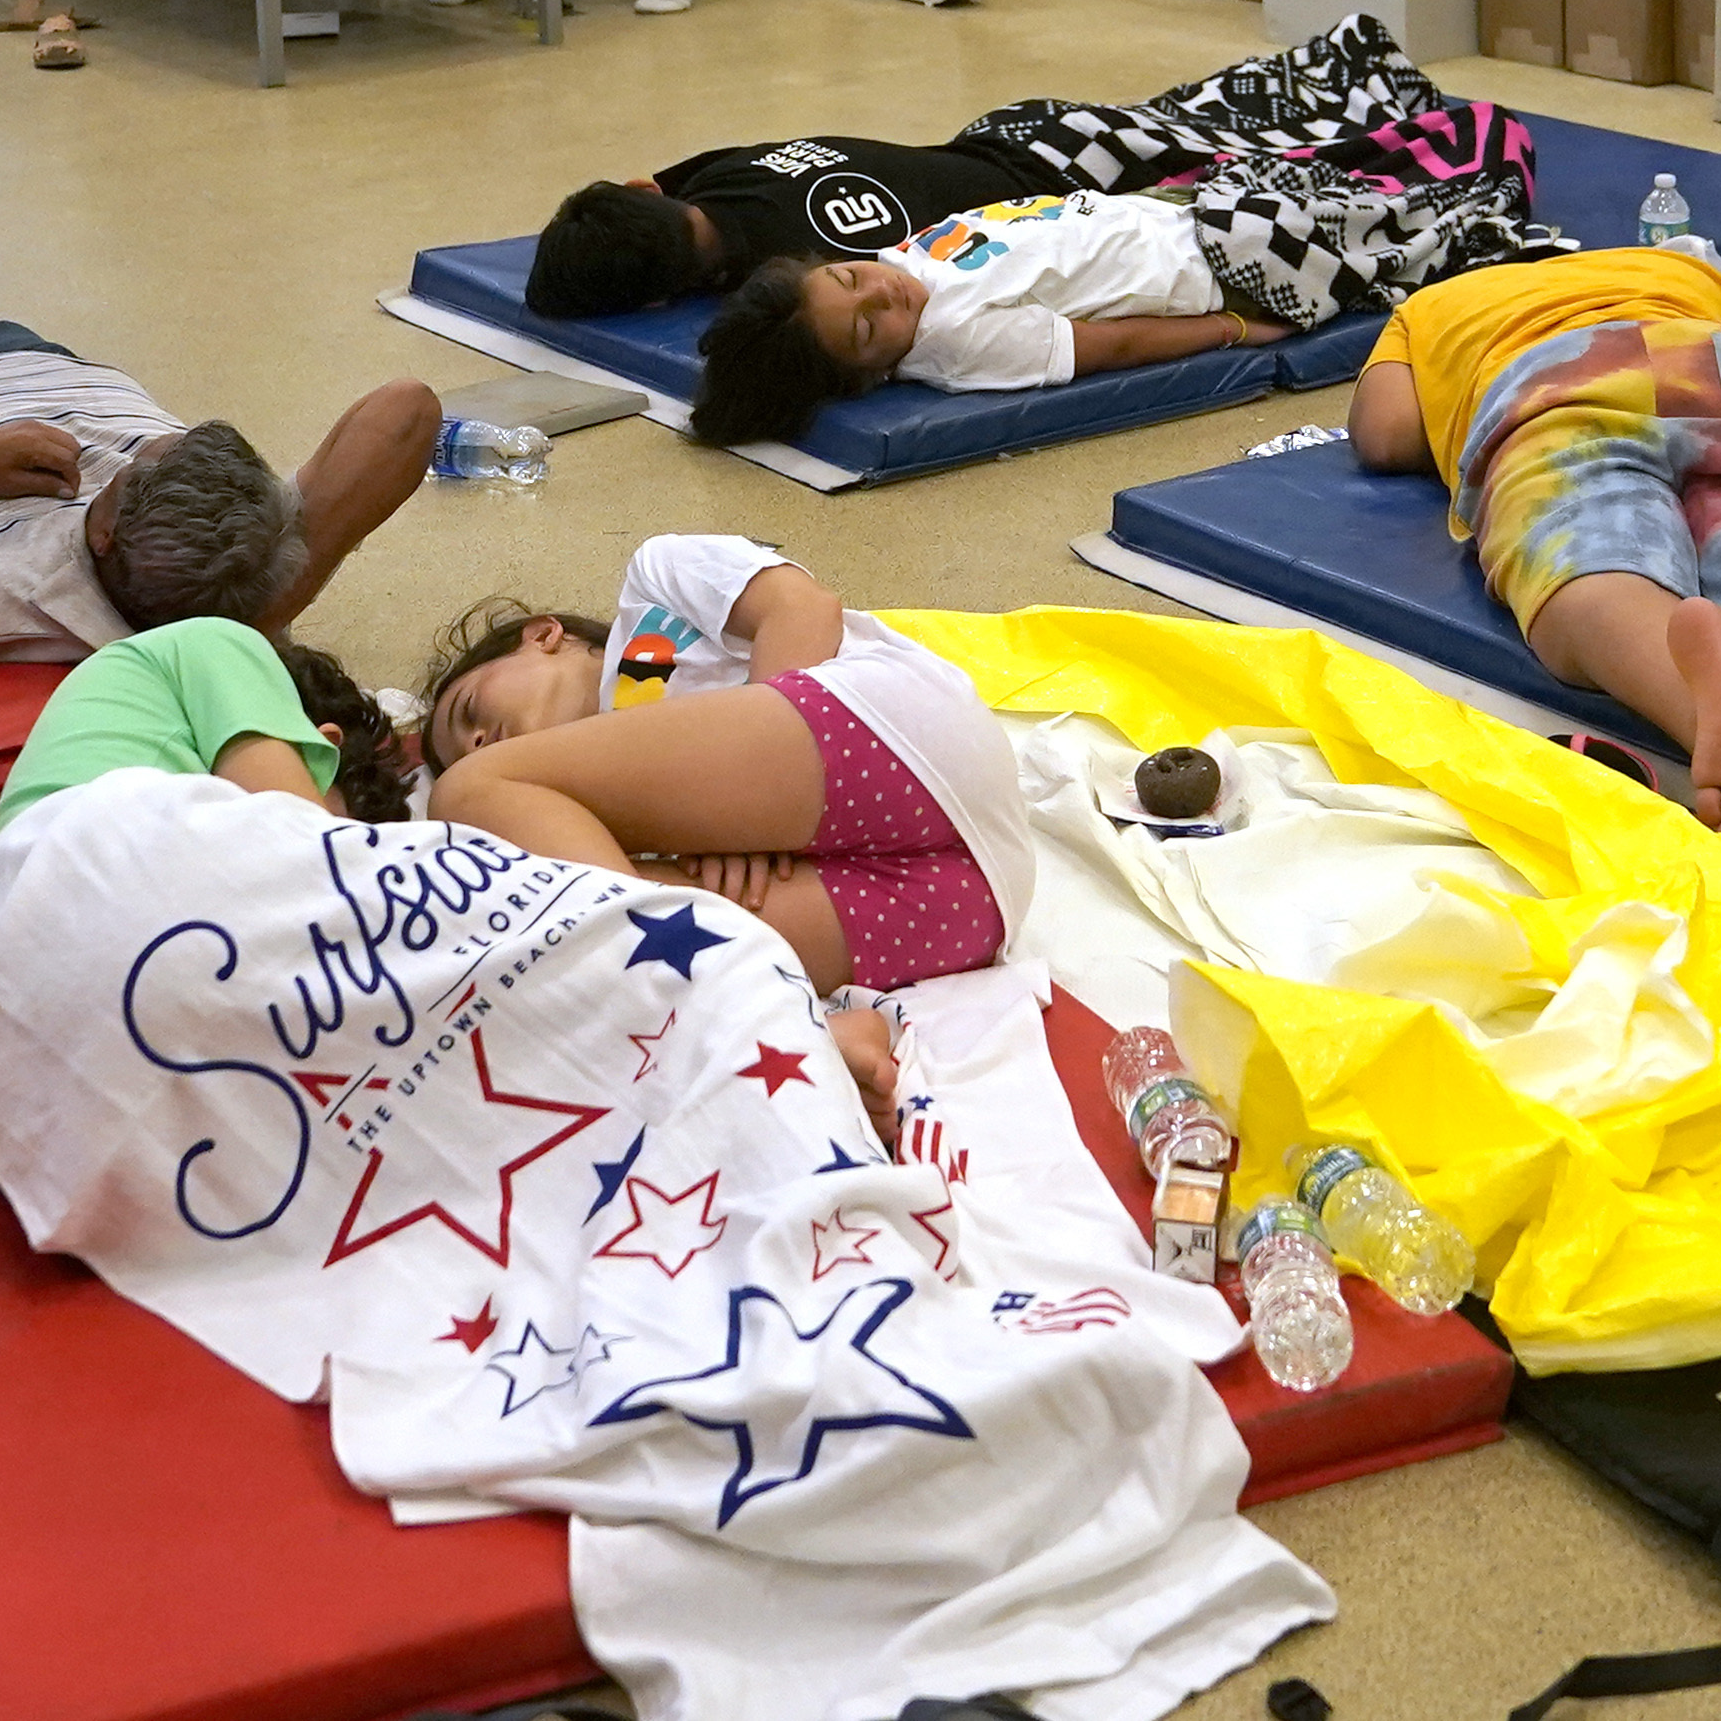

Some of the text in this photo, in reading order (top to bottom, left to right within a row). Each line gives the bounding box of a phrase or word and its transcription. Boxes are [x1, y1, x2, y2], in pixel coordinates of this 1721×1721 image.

[775, 142, 836, 169] PARK
[346, 1103, 393, 1154] THE
[396, 996, 493, 1098] UPTOWN
